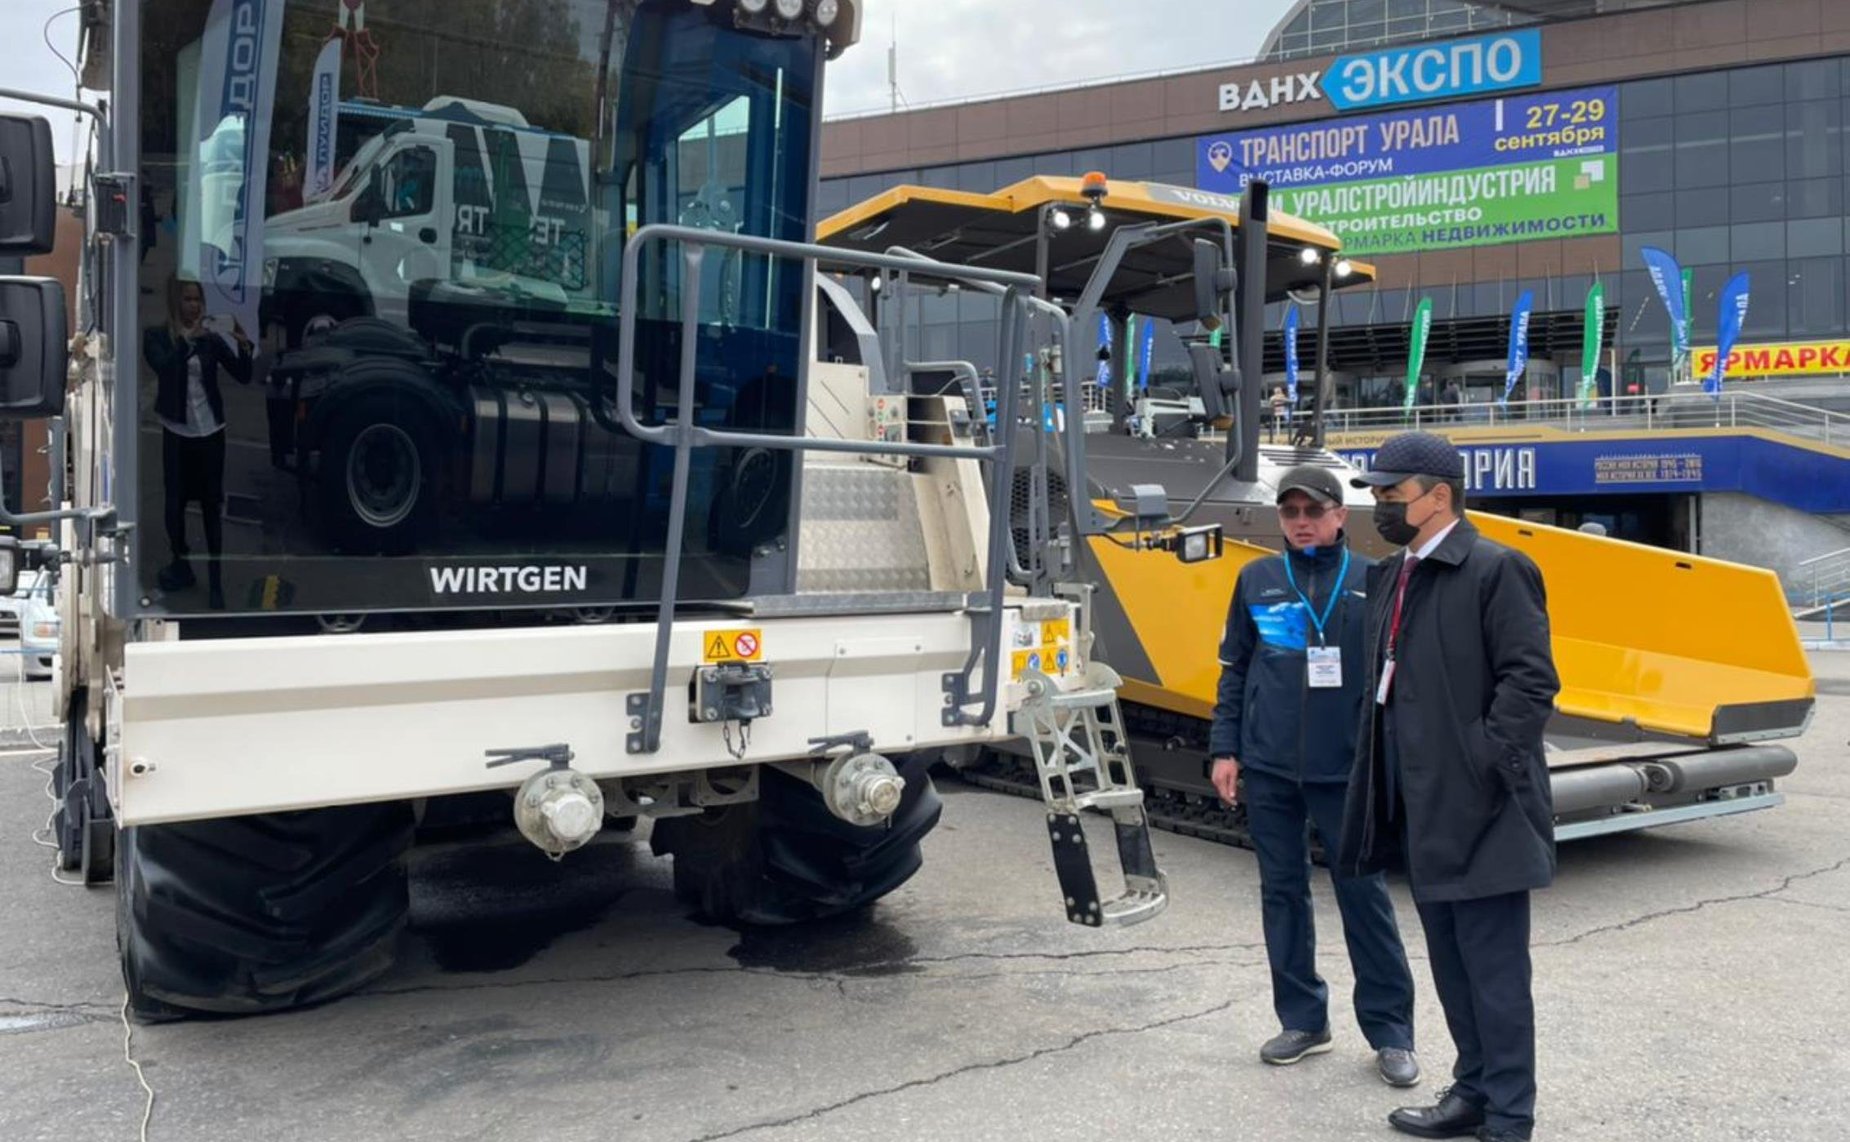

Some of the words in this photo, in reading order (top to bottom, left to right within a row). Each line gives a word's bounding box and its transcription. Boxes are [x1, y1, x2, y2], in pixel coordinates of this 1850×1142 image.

[1218, 71, 1321, 111] ВДНХ
[1343, 38, 1521, 101] ЭКСПО
[1526, 99, 1605, 129] 27-29
[1239, 125, 1368, 167] ТРАНСПОРТ
[1381, 114, 1460, 152] УРАЛА
[1494, 125, 1605, 151] сентября
[1294, 164, 1556, 217] УРАЛСТРОЙИНДУСТРИЯ
[1344, 229, 1417, 249] РМАРКА
[1422, 213, 1605, 243] НЕДВИЖИМОСТИ
[430, 566, 587, 593] WIRTGEN
